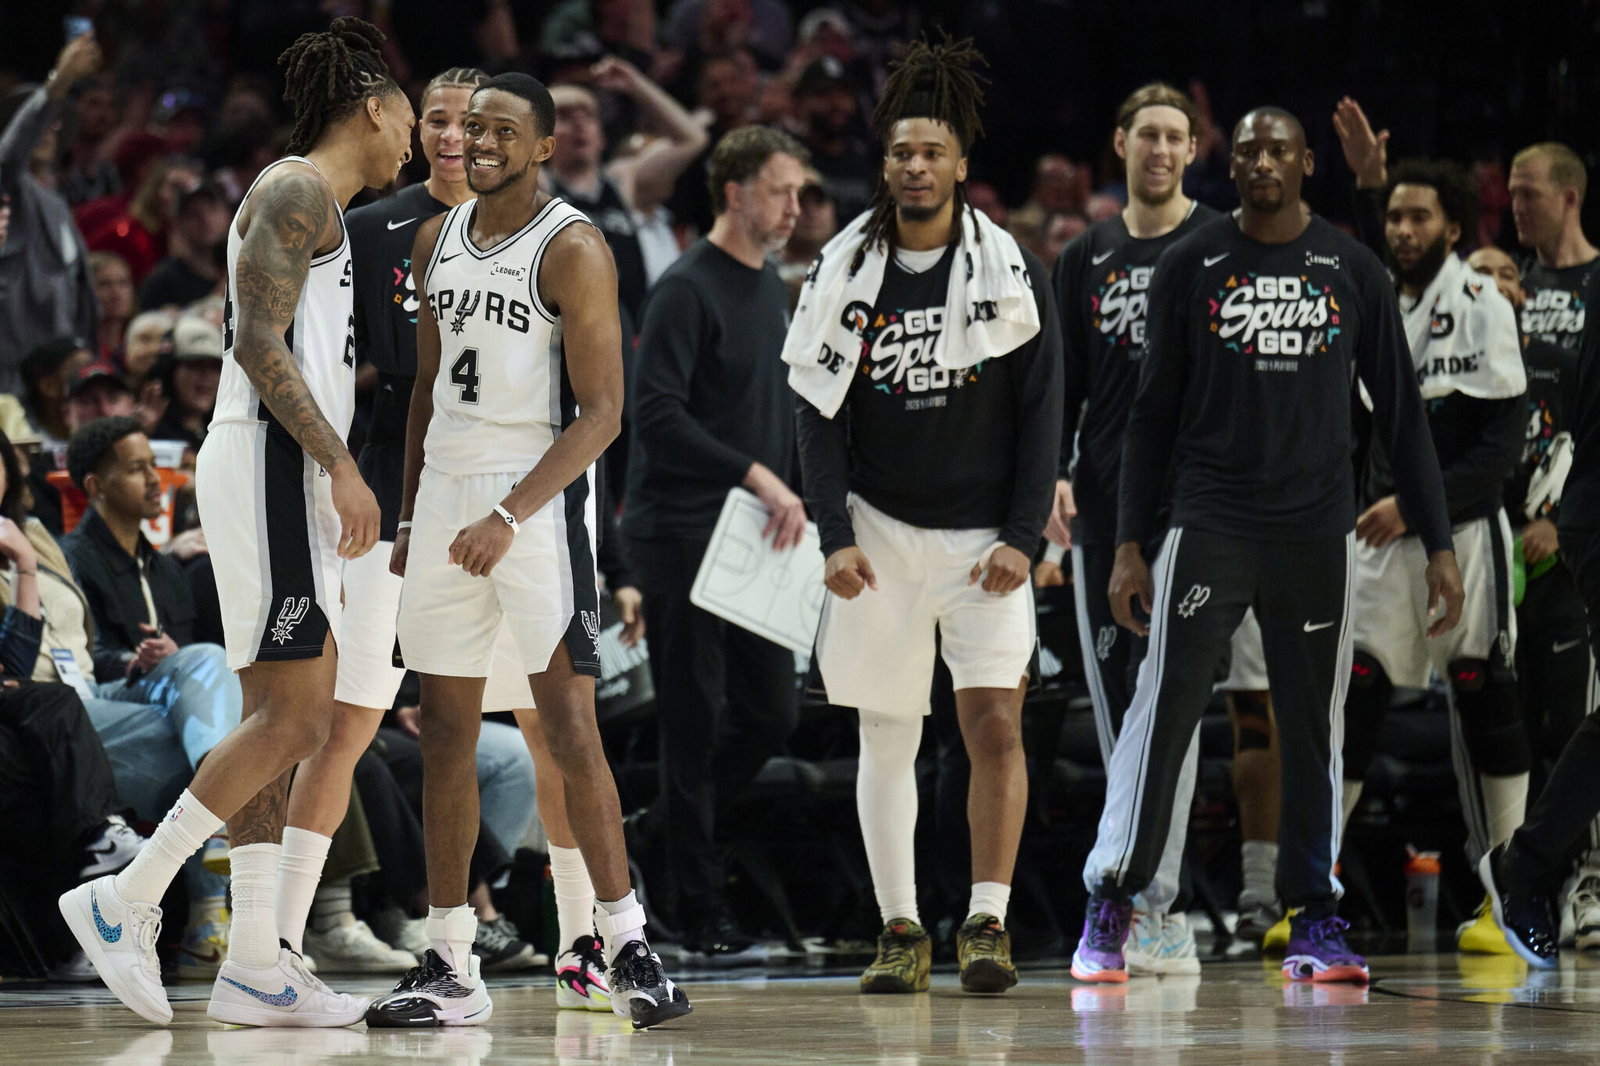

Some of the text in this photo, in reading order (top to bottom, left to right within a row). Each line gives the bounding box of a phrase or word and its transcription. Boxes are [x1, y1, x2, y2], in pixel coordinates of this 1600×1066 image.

[495, 265, 521, 277] LEDGER
[1130, 266, 1155, 290] G
[1255, 276, 1301, 300] GO
[1535, 289, 1571, 311] GO
[904, 306, 945, 335] GO
[1218, 285, 1328, 344] Spurs
[1130, 320, 1147, 344] G
[1258, 330, 1303, 355] GO
[870, 322, 937, 385] Spu
[450, 346, 481, 405] 4
[907, 366, 950, 392] GO
